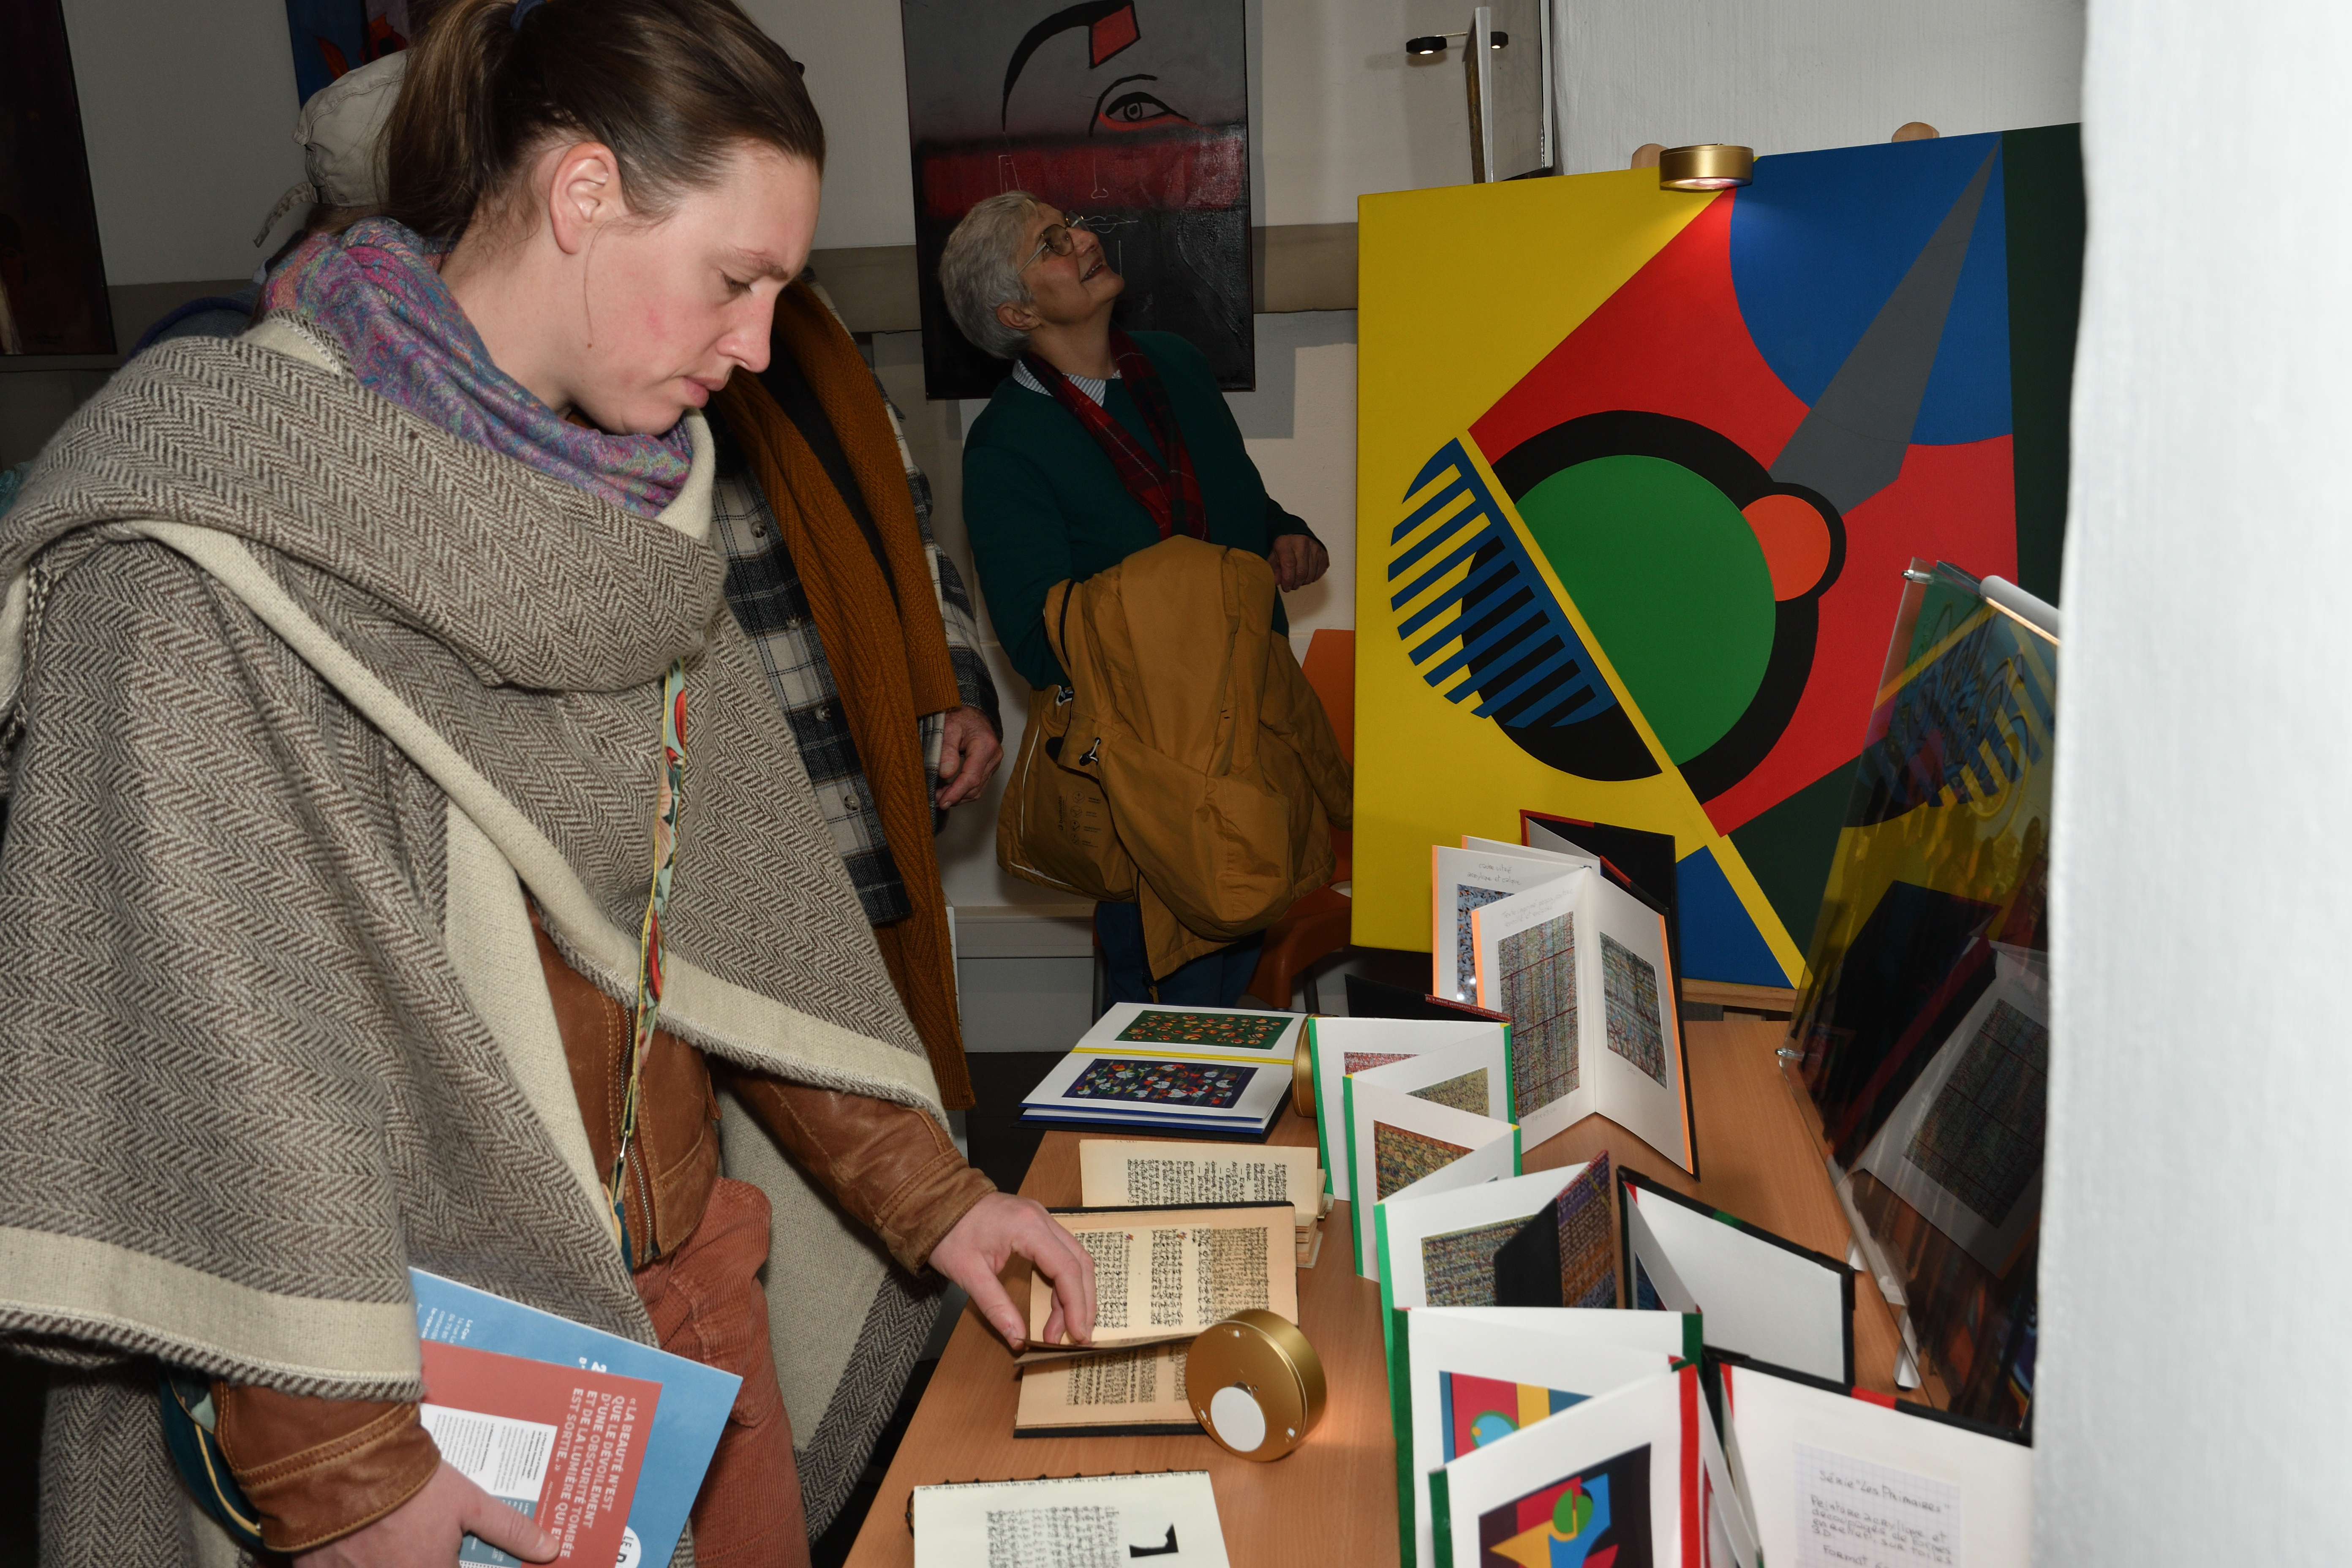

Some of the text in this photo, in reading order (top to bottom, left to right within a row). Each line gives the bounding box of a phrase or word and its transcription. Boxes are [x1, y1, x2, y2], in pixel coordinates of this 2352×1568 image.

[441, 1313, 455, 1339] 04 75 80
[460, 1319, 473, 1340] Le Cpa
[579, 1357, 588, 1369] D'
[591, 1361, 607, 1373] 2
[569, 1387, 584, 1412] EST
[584, 1389, 598, 1407] ET
[580, 1407, 593, 1426] DE
[623, 1405, 637, 1423] LA
[555, 1413, 577, 1464] SORTIE.
[574, 1426, 588, 1444] LA
[610, 1423, 634, 1473] BEAUTÉ
[560, 1444, 585, 1501] LUMIÈRE
[581, 1394, 625, 1529] QUE LE DÉVOILEMENT
[559, 1392, 612, 1559] D'UNE OBSCURITÉ TOMBÉE
[600, 1473, 619, 1511] N'EST
[551, 1500, 569, 1526] QUI
